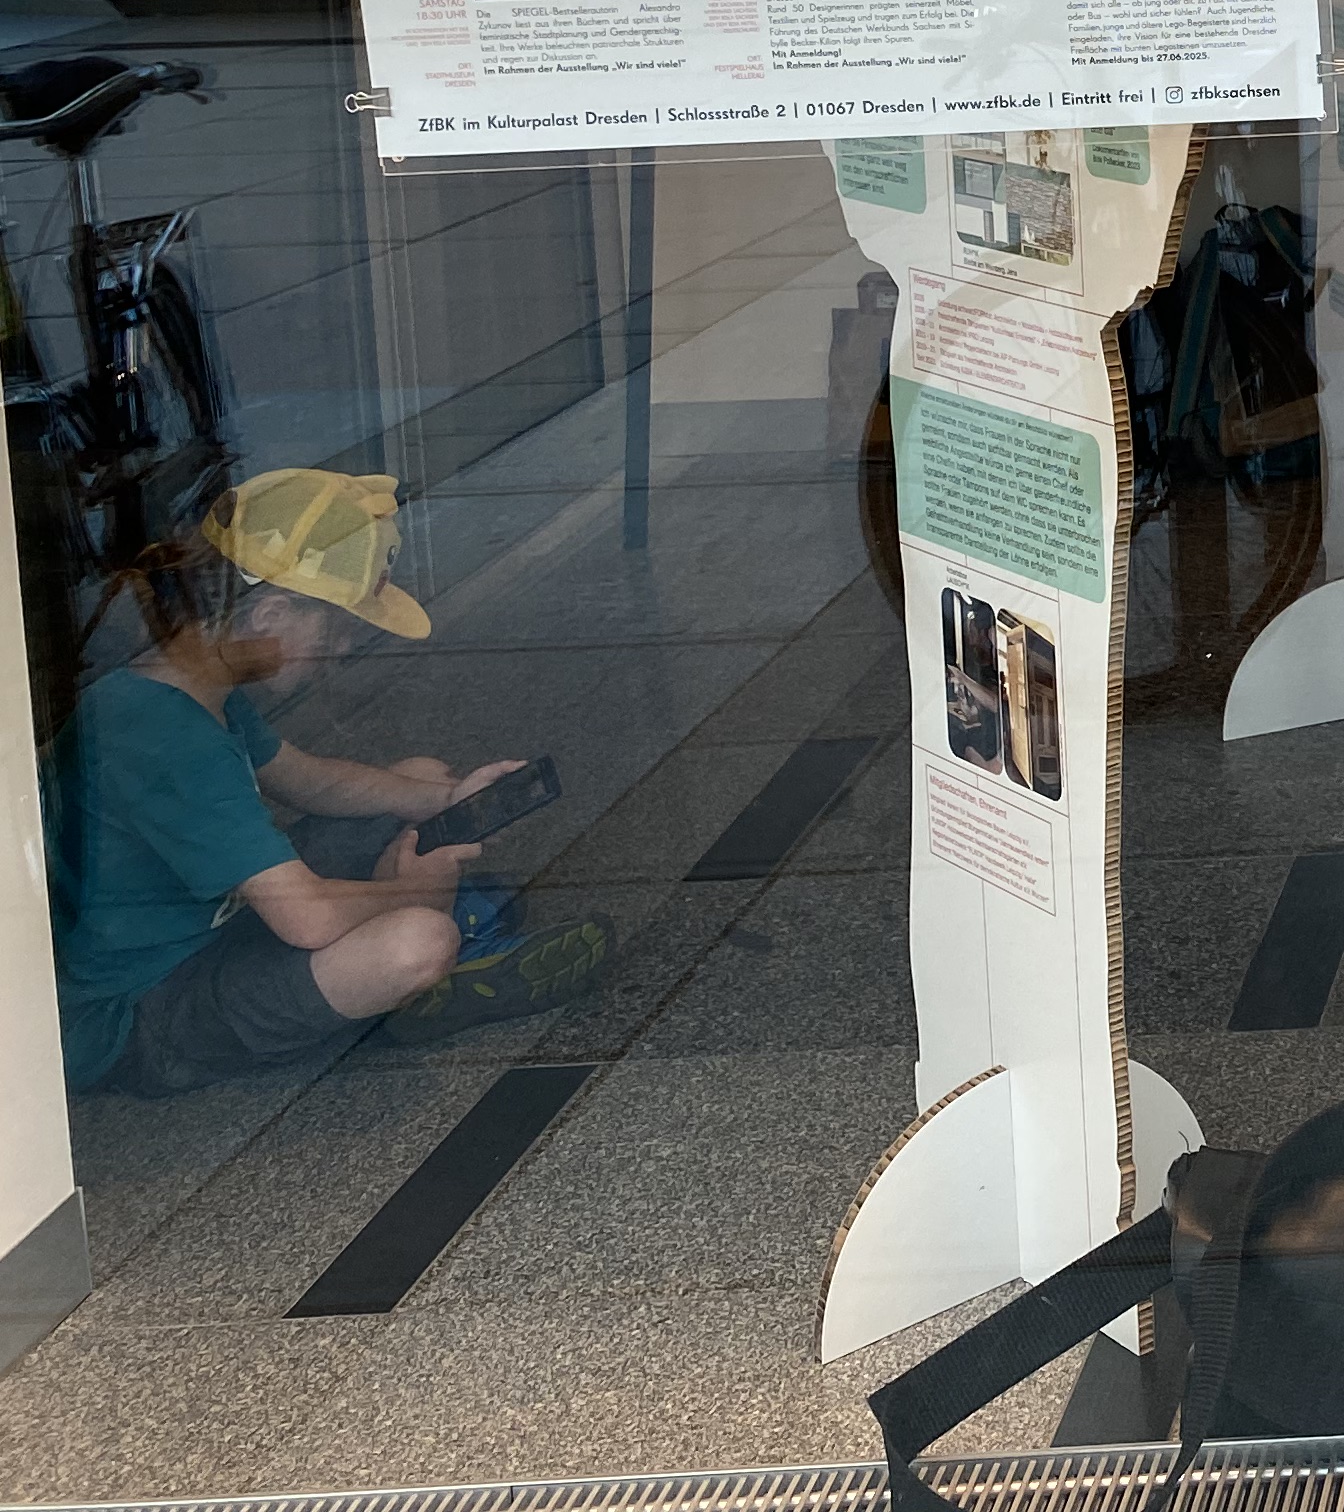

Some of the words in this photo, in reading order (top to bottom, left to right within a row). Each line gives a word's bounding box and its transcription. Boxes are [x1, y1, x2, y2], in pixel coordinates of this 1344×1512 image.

[862, 100, 924, 114] Dresden
[944, 94, 1041, 113] www.zfbk.de
[1062, 91, 1112, 105] Eintritt
[1119, 89, 1143, 103] frei
[1190, 85, 1280, 100] zfbksachsen
[419, 117, 455, 132] ZfBK
[463, 117, 480, 130] im
[487, 113, 578, 132] Kulturpalast
[585, 108, 647, 125] Dresden
[668, 104, 769, 122] Schlossstraße
[776, 104, 786, 117] 2
[806, 101, 855, 116] 01067
